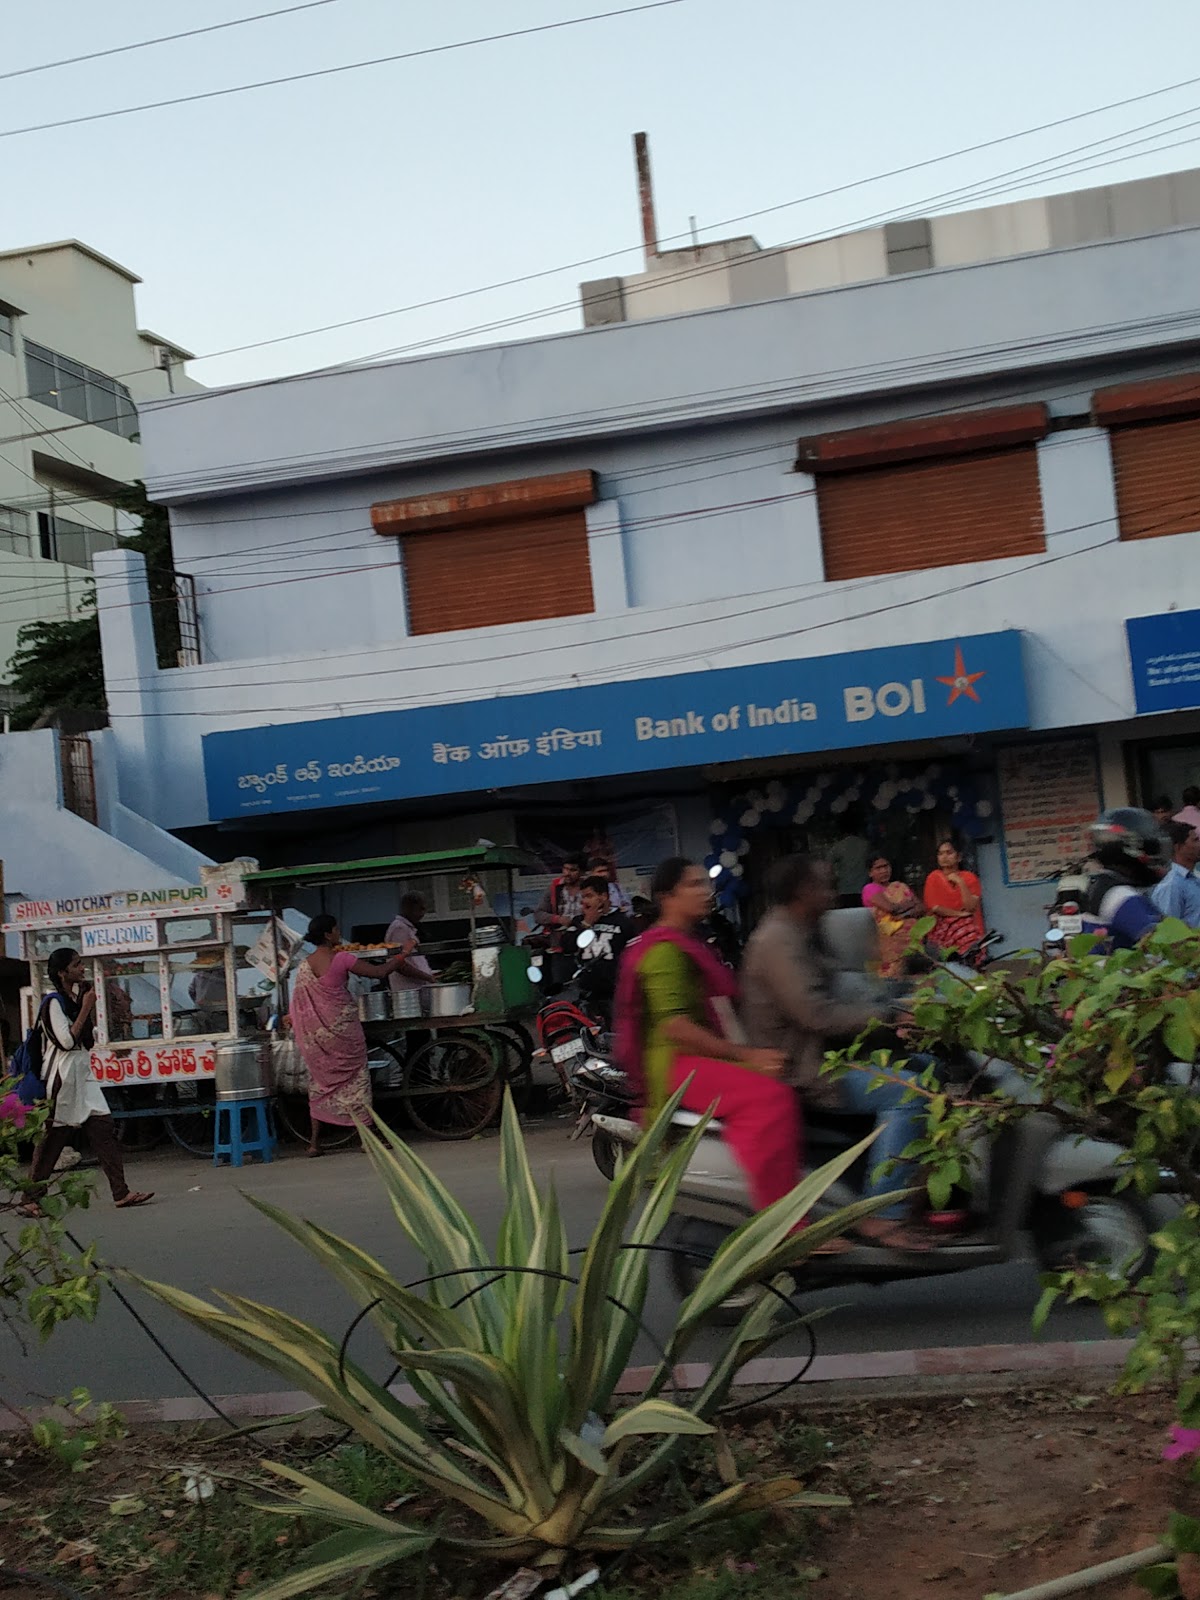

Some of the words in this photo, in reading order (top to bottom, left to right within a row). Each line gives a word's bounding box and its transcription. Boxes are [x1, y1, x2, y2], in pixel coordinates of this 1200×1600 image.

[842, 678, 927, 723] BOI
[635, 711, 706, 741] Bank
[710, 705, 741, 733] of
[747, 698, 818, 728] India
[431, 742, 472, 765] बैंक
[535, 727, 603, 757] इंडिया
[327, 754, 401, 778] ఇండియా
[16, 901, 53, 920] SHIVA
[126, 886, 209, 907] PANIPURI
[84, 925, 154, 949] WELCOME
